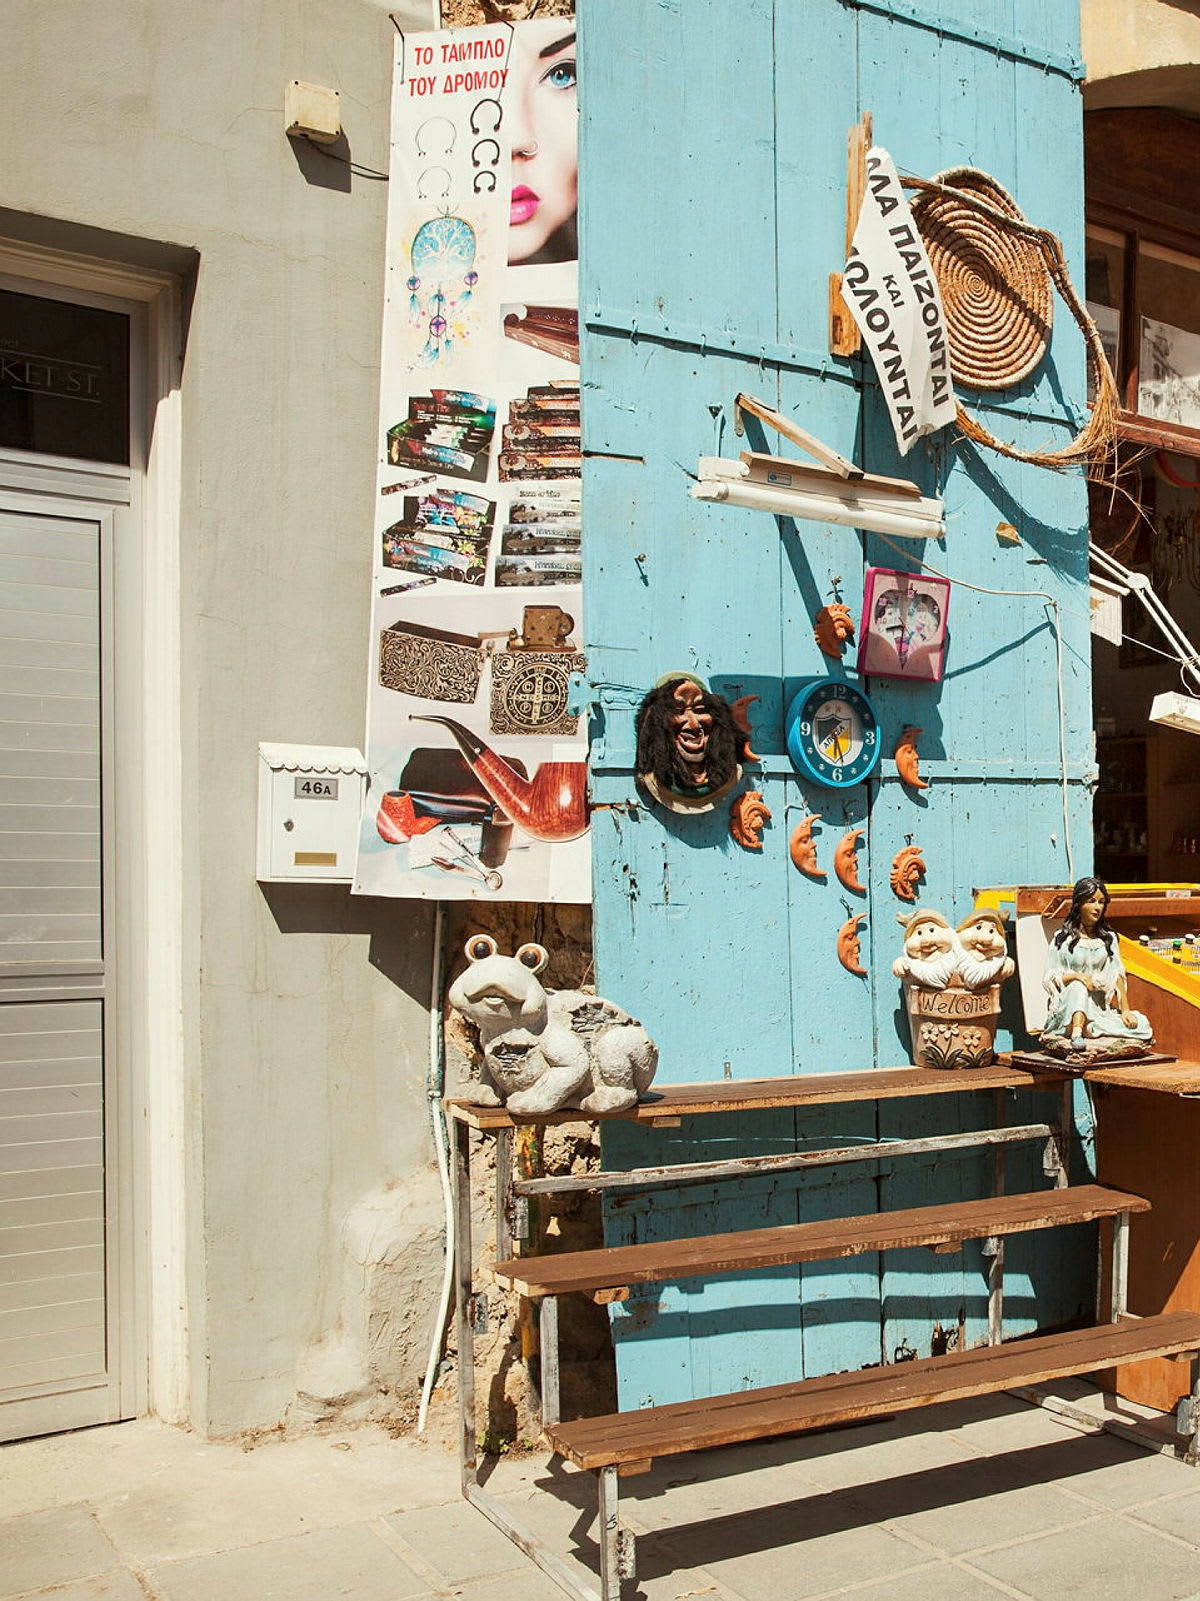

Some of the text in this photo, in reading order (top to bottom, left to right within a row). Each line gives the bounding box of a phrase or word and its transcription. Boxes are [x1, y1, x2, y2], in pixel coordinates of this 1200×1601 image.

[414, 38, 505, 66] ΤΟ ΤΑΜΠΛΟ
[408, 68, 509, 97] ΤΟΥ ΔΡΟΜΟΥ
[882, 274, 905, 308] ΚΑΙ
[888, 224, 950, 409] ΠΑΙΖΟΝΤΑΙ
[844, 246, 917, 442] ΩΛΟΥΝΤΑΙ
[833, 686, 847, 699] 12
[800, 721, 811, 736] 9
[865, 731, 875, 745] 3
[832, 768, 843, 782] 6
[301, 781, 332, 795] 46A
